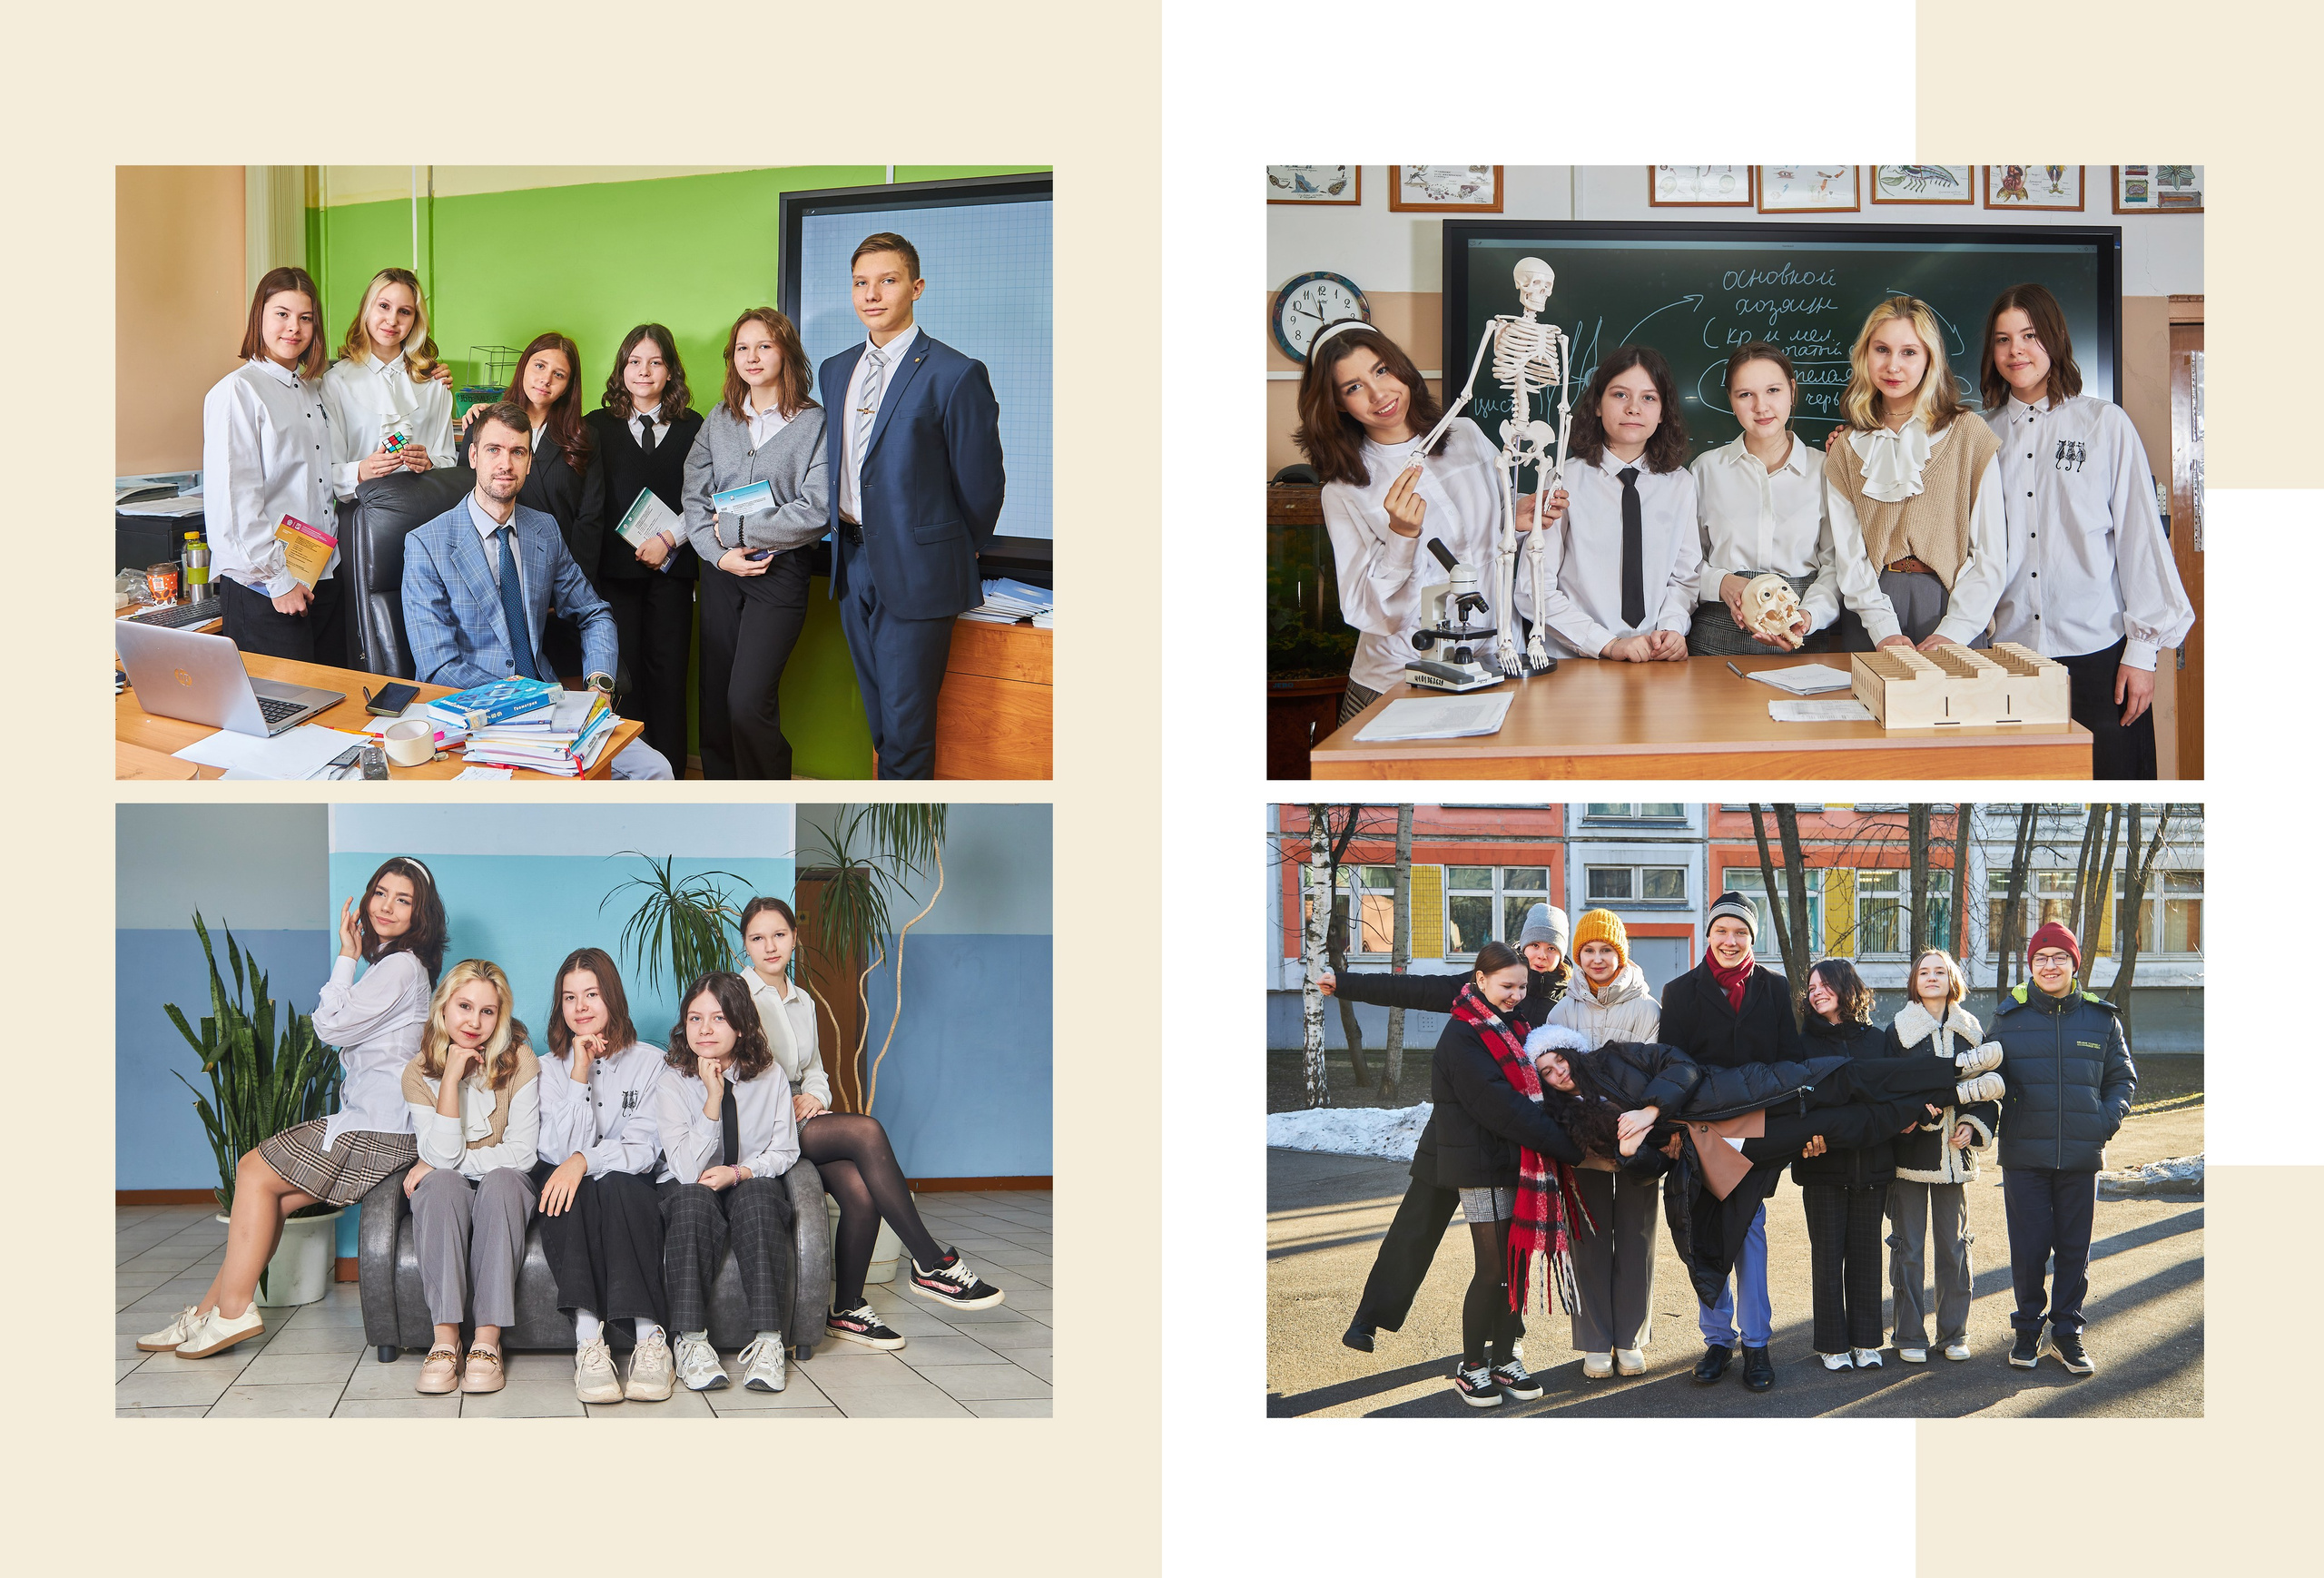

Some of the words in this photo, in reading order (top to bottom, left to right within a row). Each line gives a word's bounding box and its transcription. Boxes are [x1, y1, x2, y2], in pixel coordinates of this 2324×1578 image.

[1303, 290, 1310, 301] 11
[1317, 285, 1326, 296] 12
[1293, 300, 1302, 311] 10
[1344, 298, 1351, 309] 2
[1290, 315, 1296, 326] 9
[1295, 330, 1302, 340] 8
